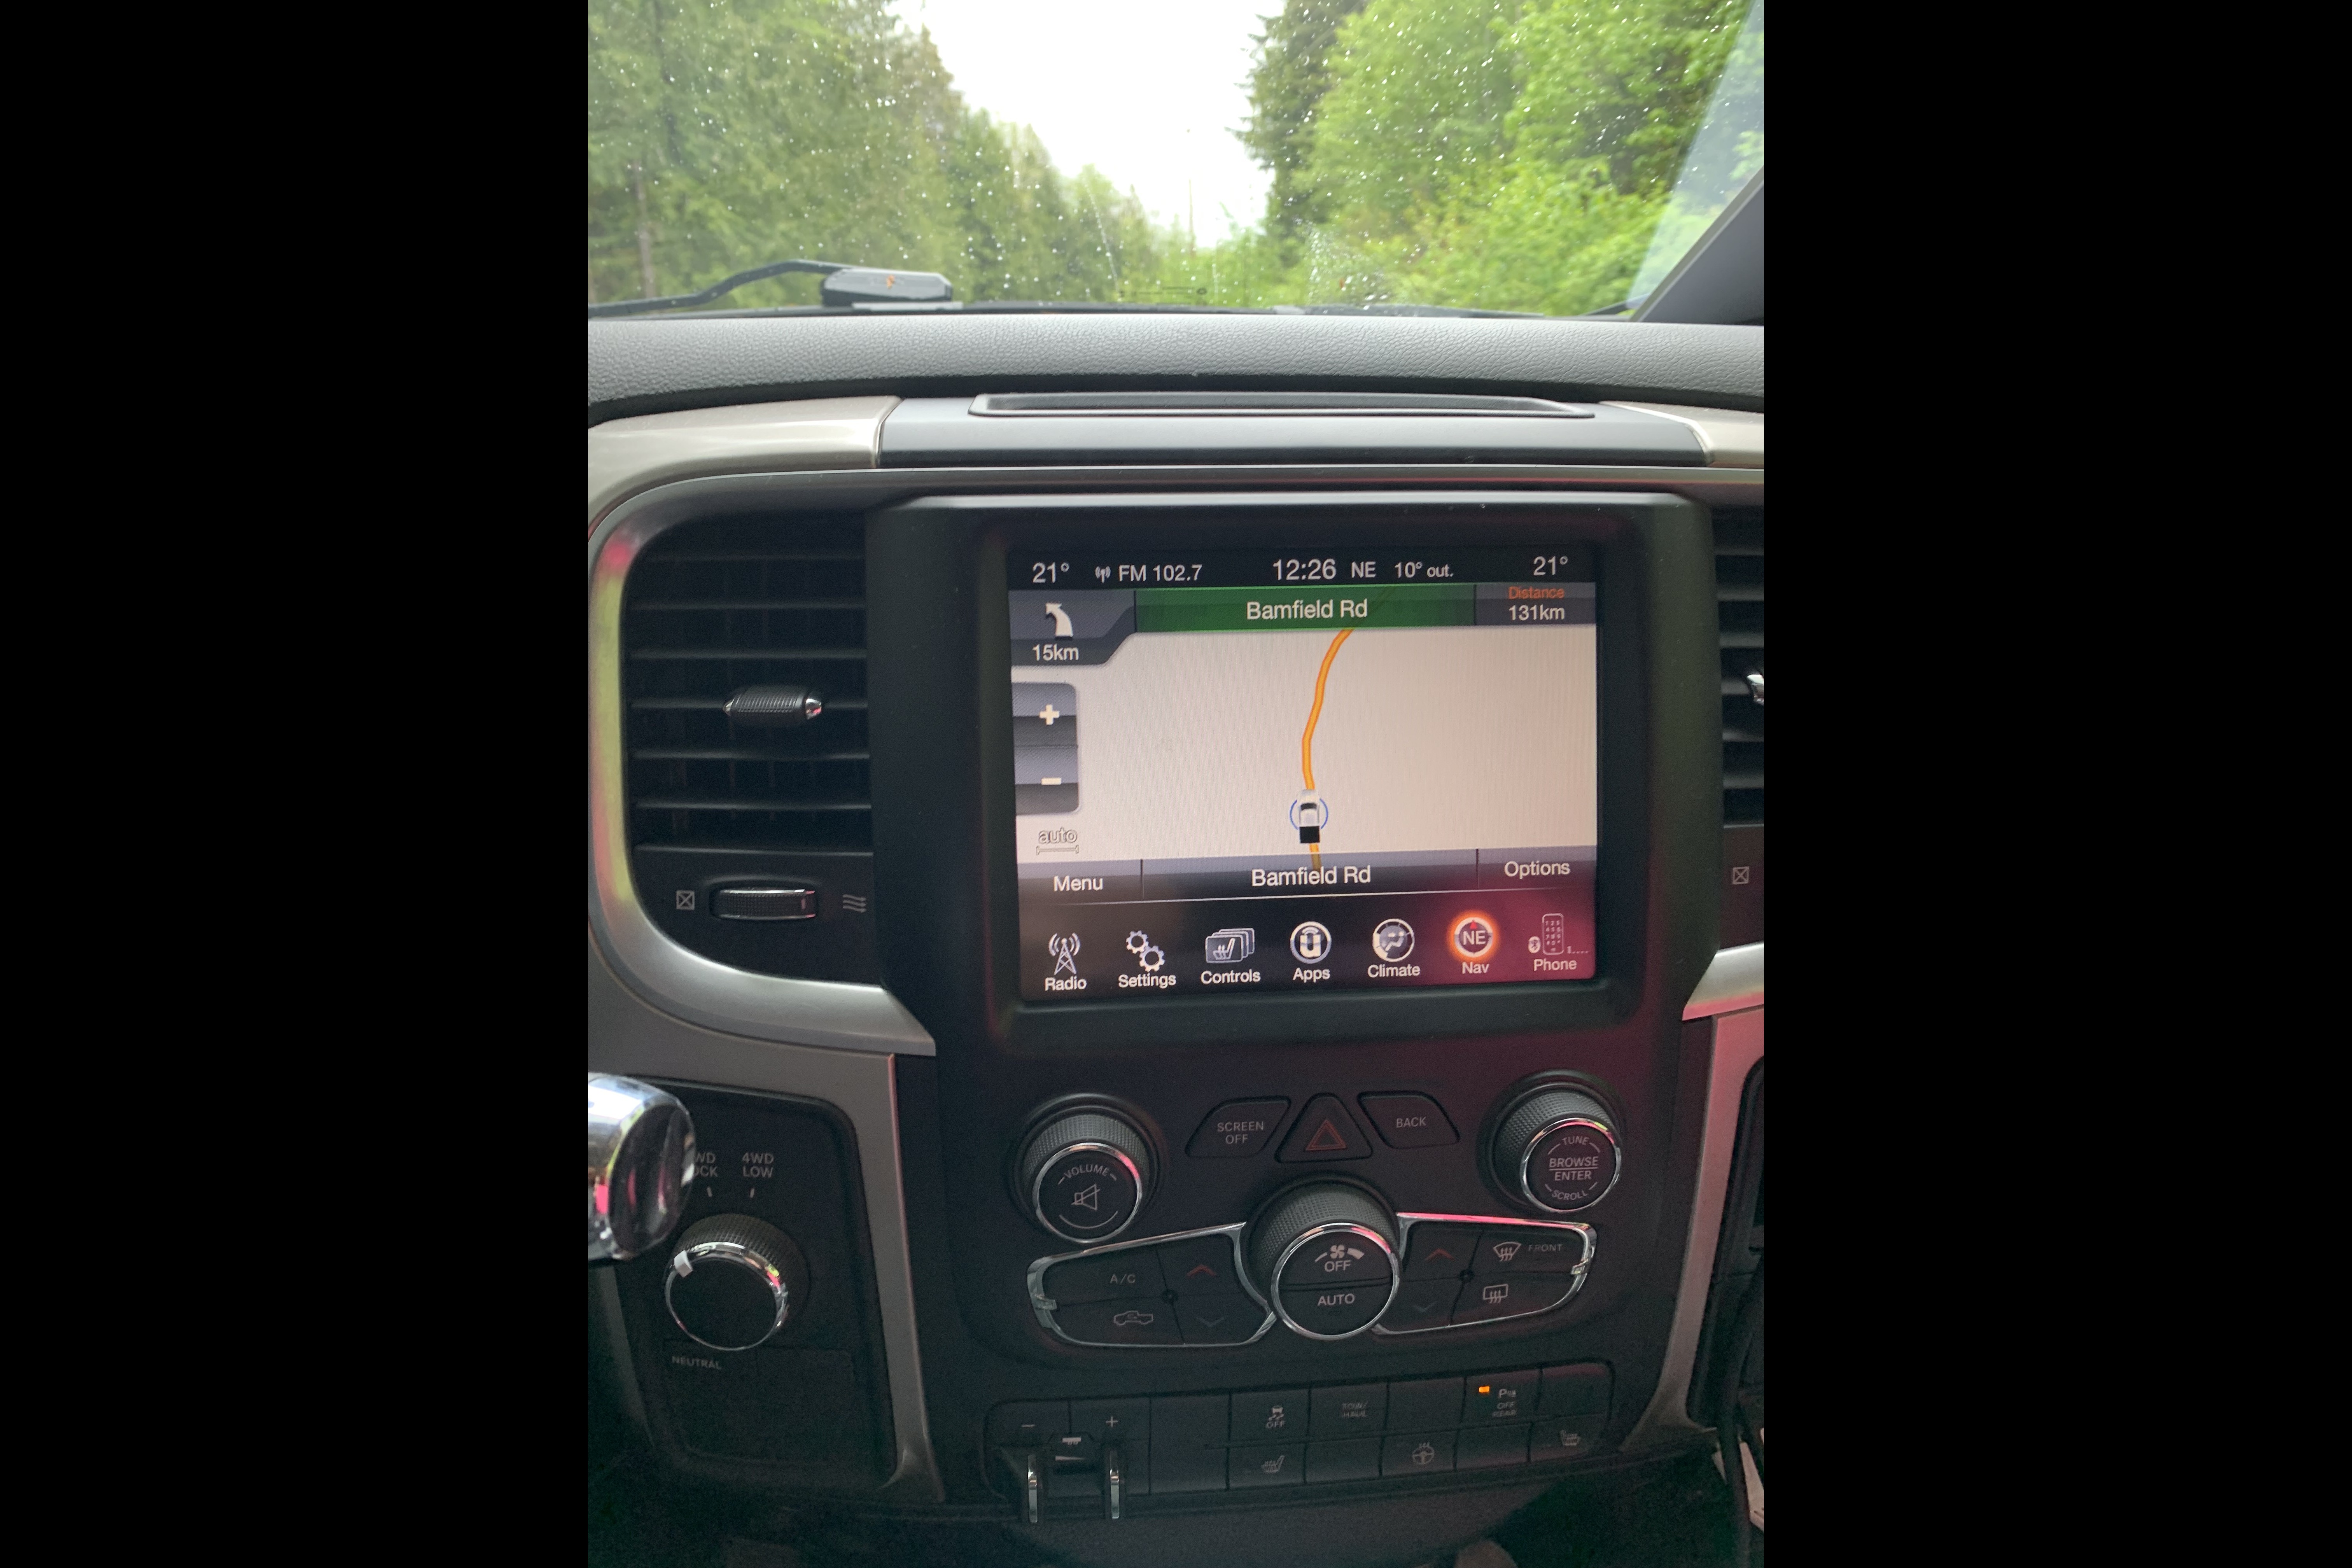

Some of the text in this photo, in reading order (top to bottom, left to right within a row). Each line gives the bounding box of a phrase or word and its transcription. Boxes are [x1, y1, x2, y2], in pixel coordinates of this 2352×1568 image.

[1032, 562, 1069, 583] 21°
[1119, 564, 1202, 581] FM 102.7
[1273, 558, 1337, 580] 12:26
[1351, 562, 1376, 578] NE
[1395, 561, 1453, 577] 10° out.
[1533, 556, 1568, 576] 21°
[1508, 586, 1565, 599] Distance
[1246, 599, 1367, 620] Bamfield Rd
[1509, 605, 1565, 620] 131km
[1032, 644, 1079, 661] 15km
[1038, 827, 1078, 843] auto
[1252, 866, 1370, 887] Bamfield Rd
[1505, 860, 1570, 879] Options
[1054, 875, 1103, 891] Menu
[1463, 931, 1486, 945] NE
[1367, 964, 1420, 978] Climate
[1462, 961, 1489, 975] Nav
[1533, 958, 1577, 971] Phone
[1118, 973, 1176, 989] Settings
[1201, 970, 1261, 985] Controls
[1293, 967, 1330, 983] Apps
[1044, 975, 1087, 991] Radio
[1217, 1121, 1264, 1132] SCREEN
[1395, 1117, 1426, 1128] BACK
[1225, 1134, 1248, 1144] OFF
[1561, 1136, 1589, 1146] TUNE
[694, 1152, 716, 1164] WD
[742, 1152, 774, 1164] 4WD
[1549, 1157, 1599, 1167] BROWSE
[743, 1166, 774, 1178] LOW
[1064, 1164, 1109, 1178] VOLUME
[1554, 1170, 1592, 1181] ENTER
[1552, 1189, 1588, 1201] SCROLL
[1528, 1243, 1563, 1252] FRONT
[1324, 1260, 1351, 1272] OFF
[1110, 1274, 1136, 1284] A/C
[1317, 1294, 1355, 1306] AUTO
[672, 1355, 723, 1370] NEUTRAL
[1497, 1402, 1515, 1410] OFF
